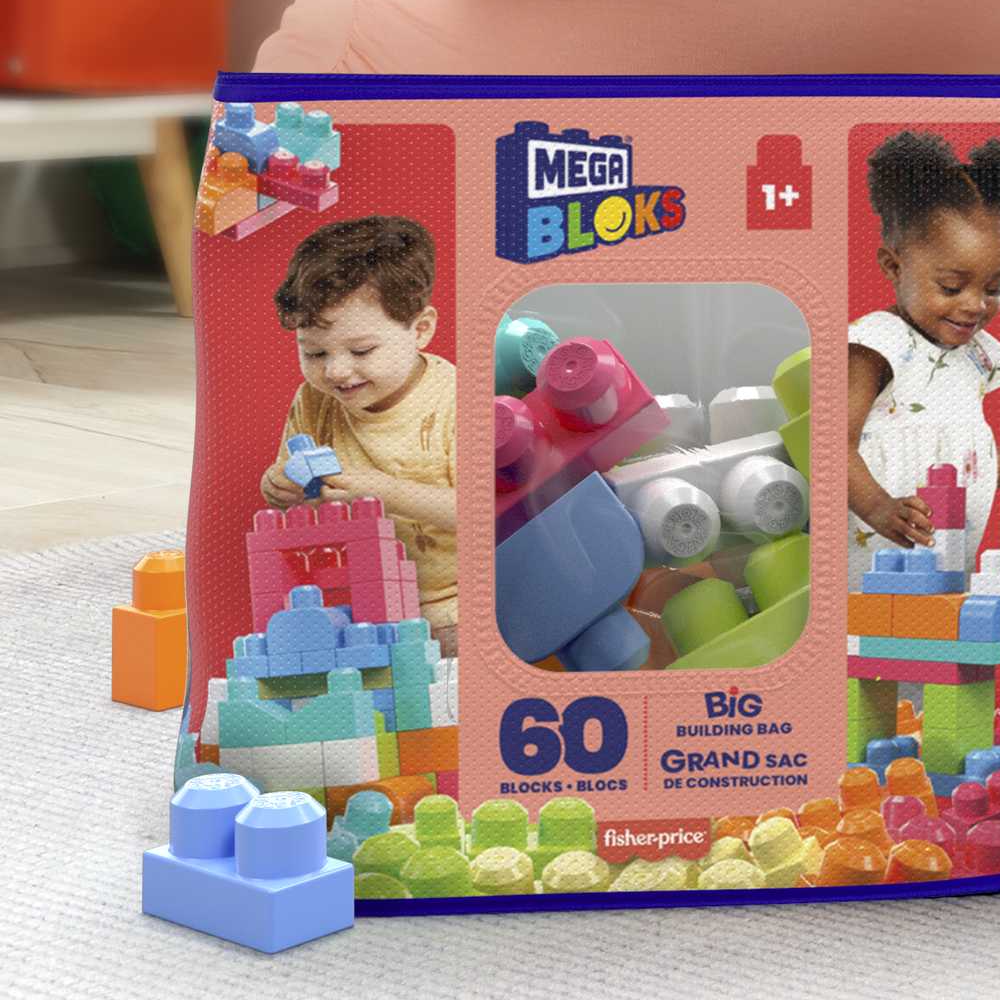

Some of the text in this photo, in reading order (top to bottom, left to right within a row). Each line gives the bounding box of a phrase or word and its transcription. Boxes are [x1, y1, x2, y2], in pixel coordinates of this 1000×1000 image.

[534, 147, 625, 191] MEGA
[761, 183, 800, 211] 1+
[527, 189, 684, 258] BLOKS
[499, 695, 629, 776] 60
[676, 722, 793, 737] BUILDING BAG
[660, 748, 808, 773] GRAND SAC
[500, 779, 628, 794] BLOCKS BLOCS
[664, 774, 808, 789] DE CONSTRUCTION
[604, 828, 705, 849] fisher-price
